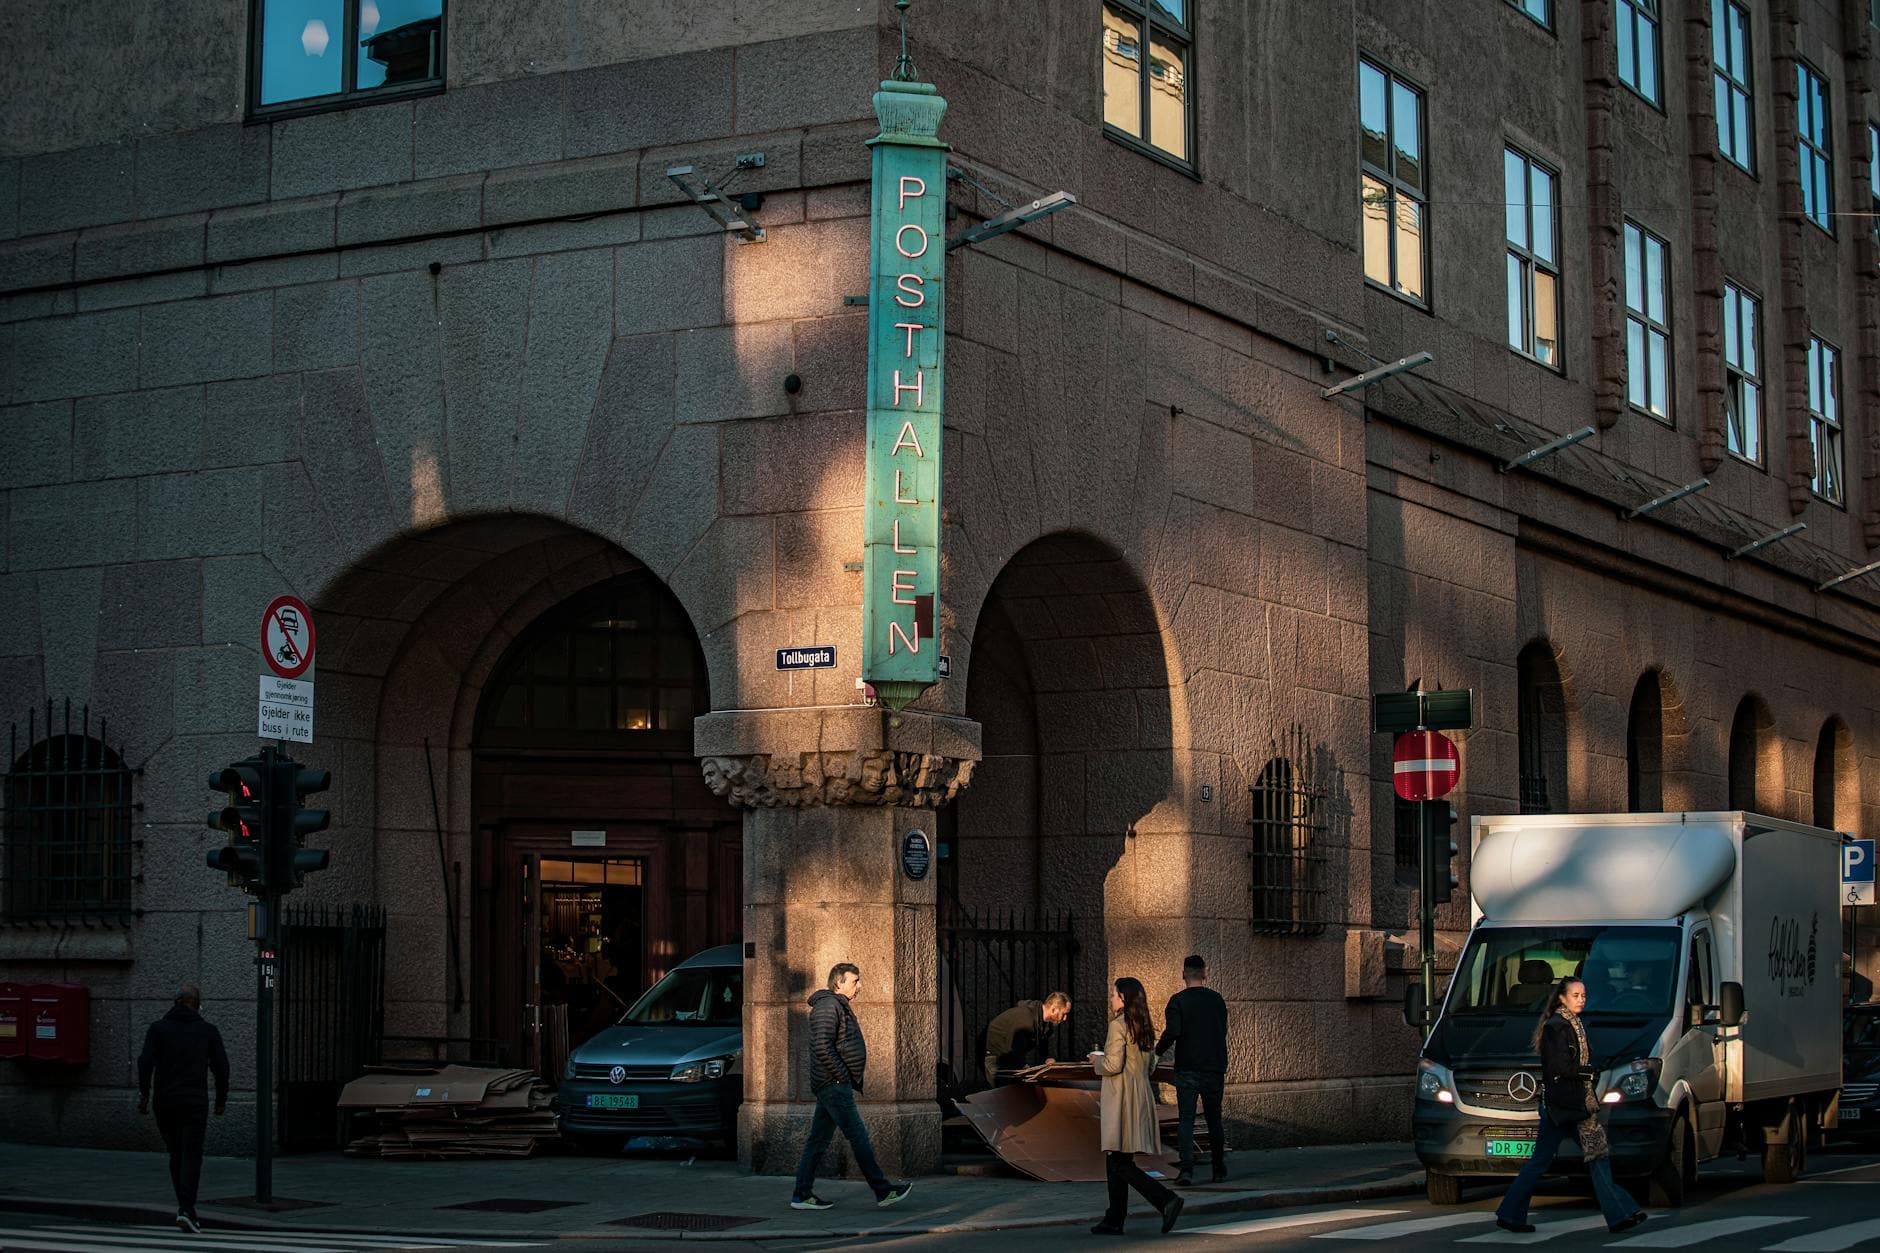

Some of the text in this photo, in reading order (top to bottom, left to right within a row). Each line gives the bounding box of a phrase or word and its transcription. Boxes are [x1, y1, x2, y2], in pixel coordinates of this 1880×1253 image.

[889, 175, 929, 657] POSTHALLEN
[781, 650, 830, 667] Tollbugata
[277, 681, 297, 691] Gjelder
[265, 691, 308, 704] gjennomkjøring
[262, 705, 310, 722] Gjelder ikke
[262, 721, 282, 734] buss
[292, 726, 309, 737] rute
[1844, 846, 1865, 877] P
[594, 1095, 635, 1107] BE 19548
[1495, 1142, 1511, 1154] DR
